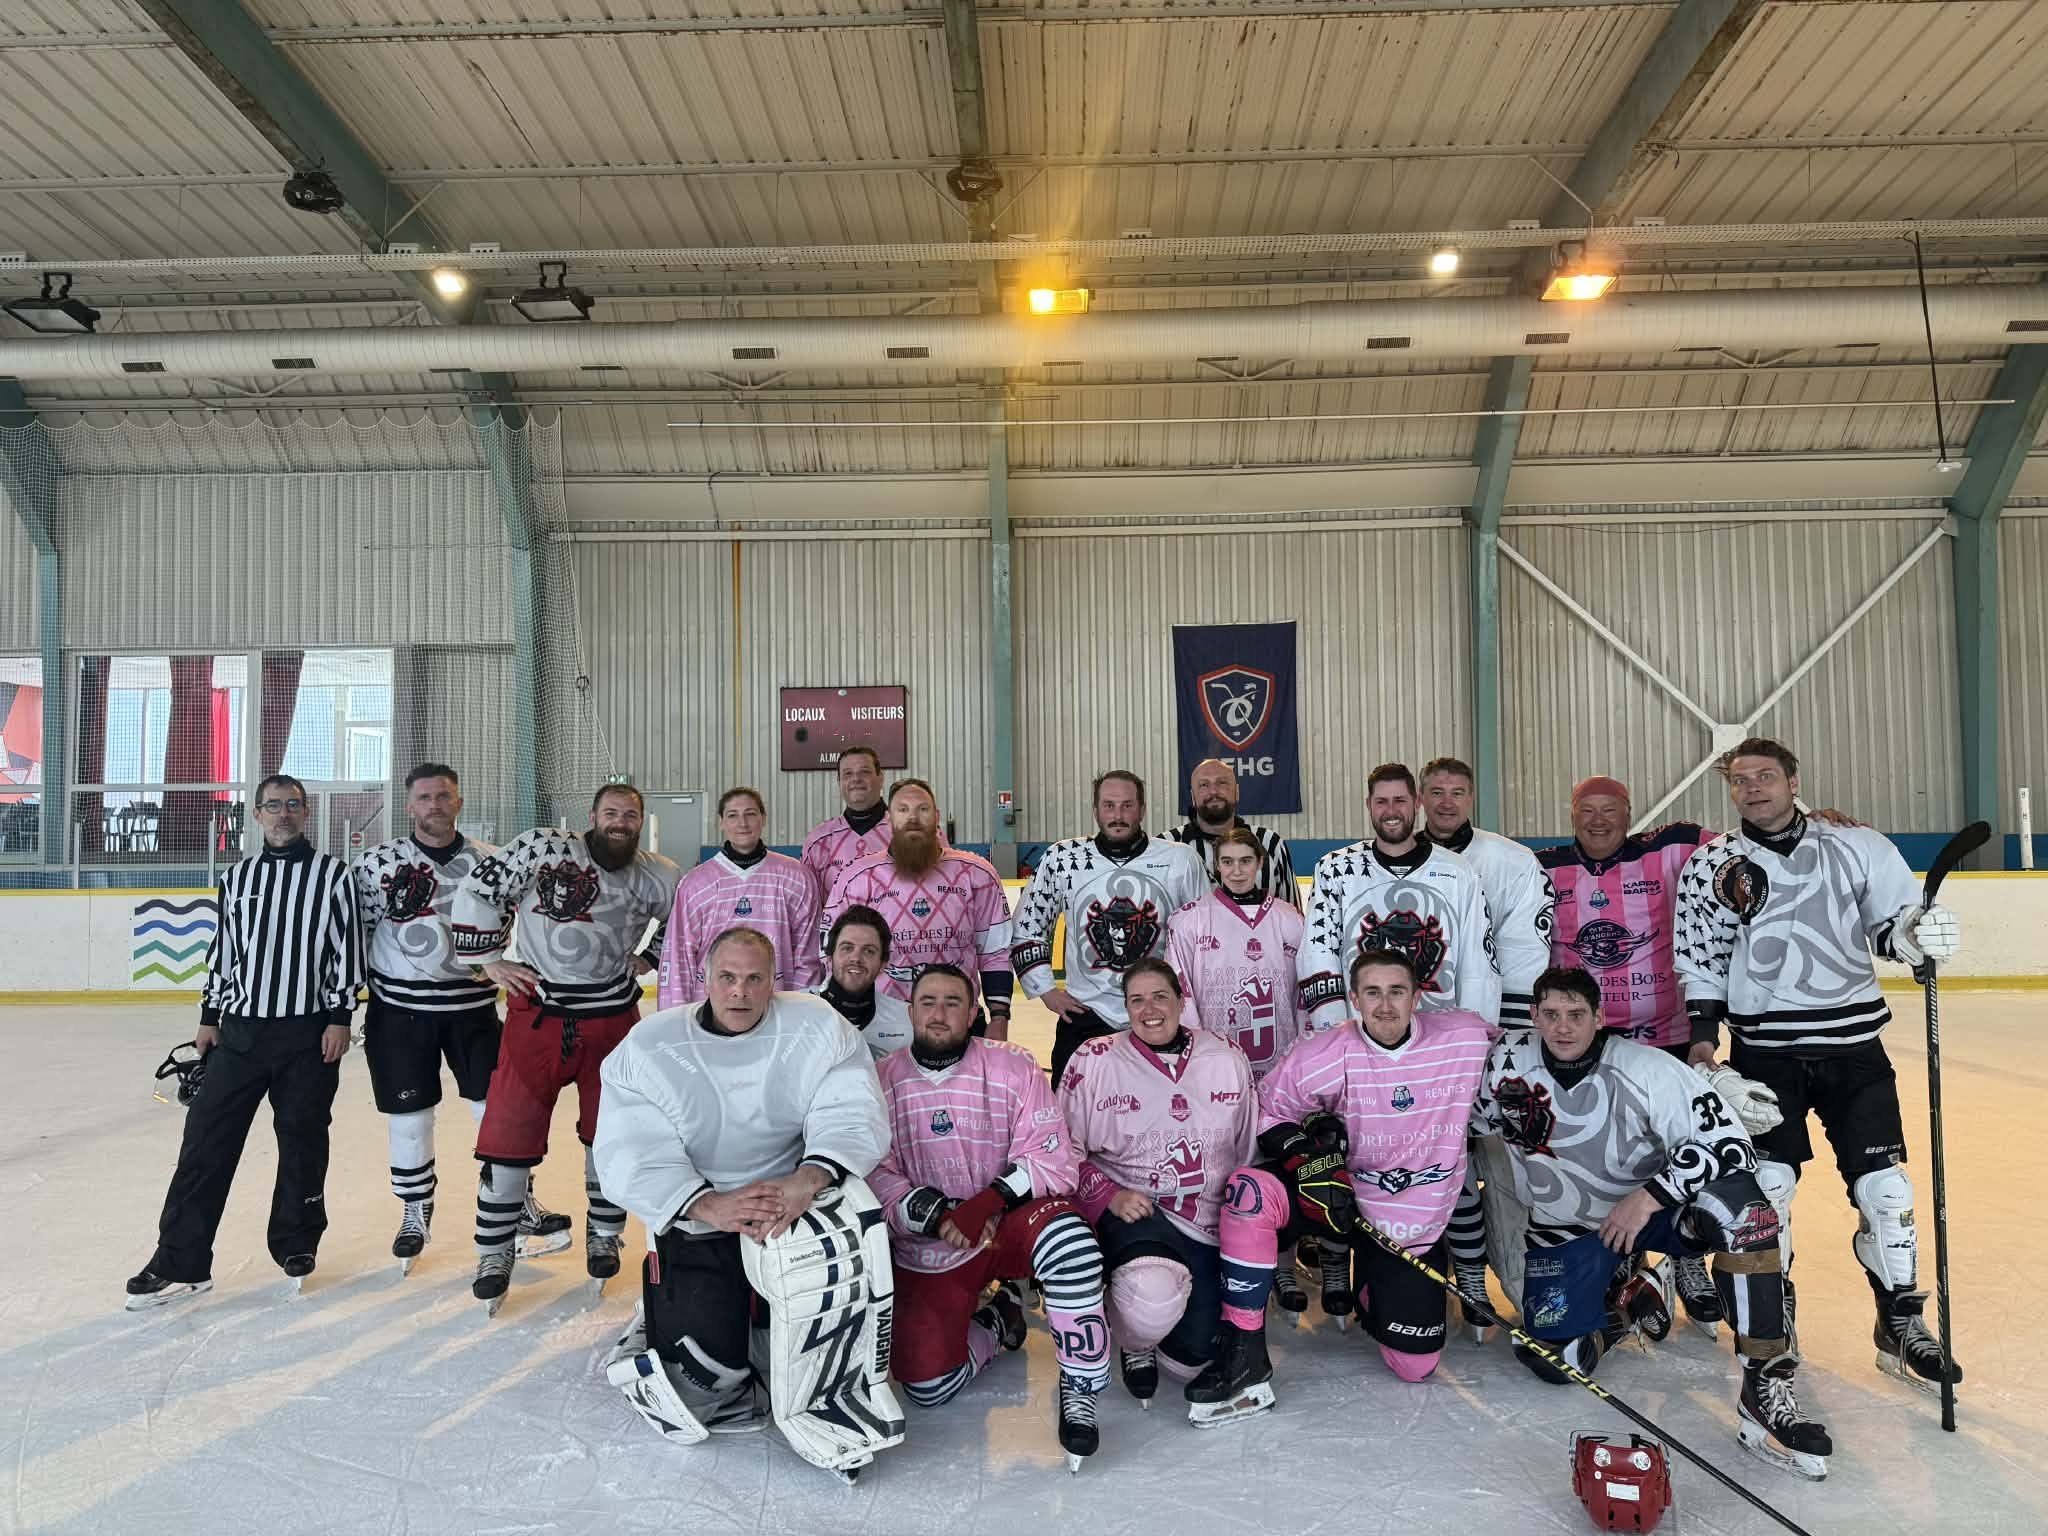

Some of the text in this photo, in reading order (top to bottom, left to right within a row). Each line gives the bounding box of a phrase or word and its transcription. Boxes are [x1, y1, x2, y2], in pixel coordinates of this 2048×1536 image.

[785, 706, 904, 722] LOCAUX VISITEURS
[1623, 880, 1661, 890] KAPPA
[1600, 976, 1629, 987] DES
[1599, 991, 1642, 1002] ITEUR
[1691, 1091, 1734, 1133] 32
[1387, 1321, 1445, 1337] BAUER
[873, 1306, 894, 1375] VAUGHN
